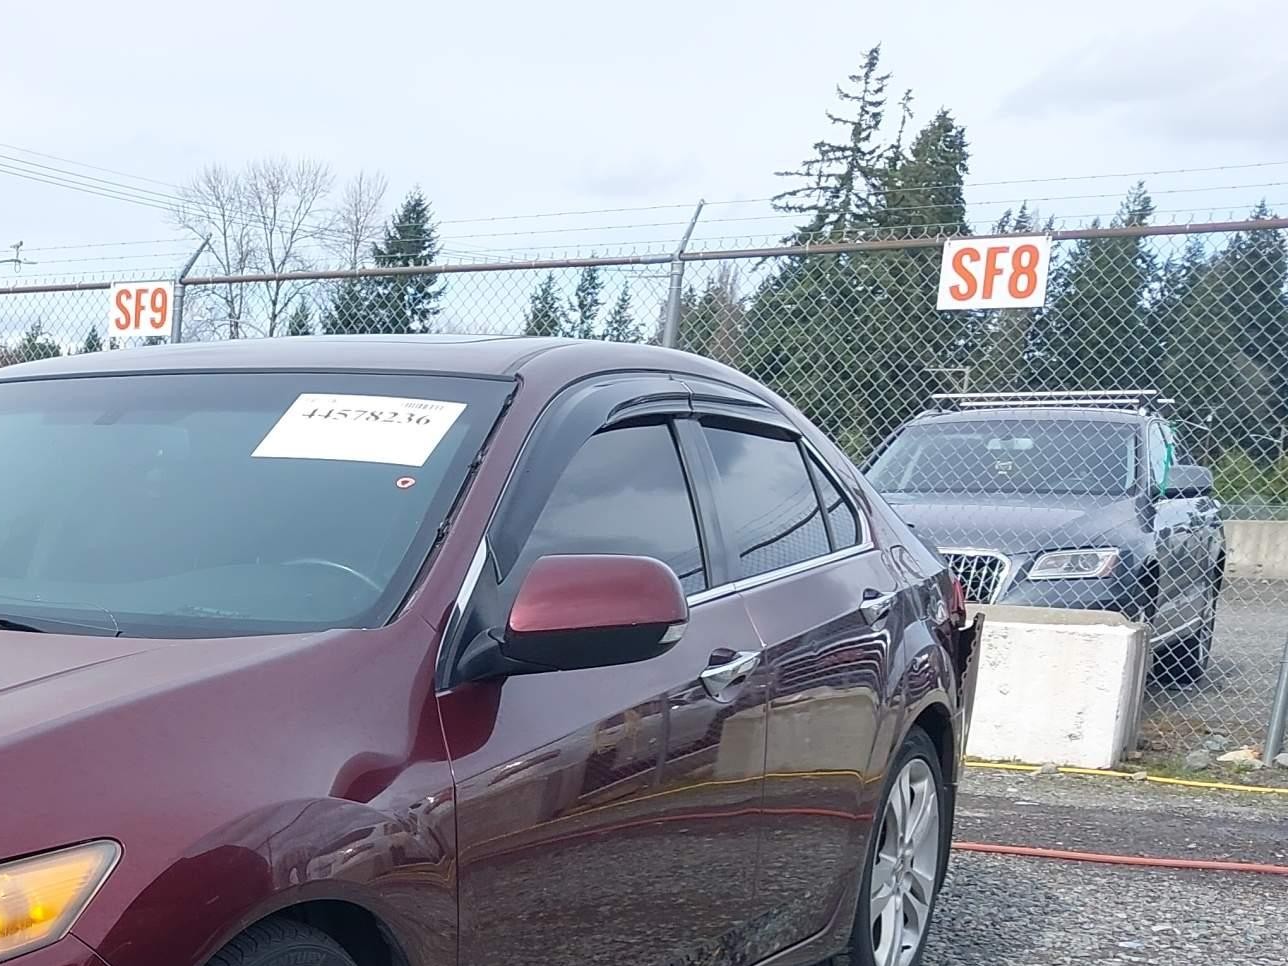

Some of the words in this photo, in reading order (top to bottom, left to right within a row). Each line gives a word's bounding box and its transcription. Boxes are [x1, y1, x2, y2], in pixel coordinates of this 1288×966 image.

[948, 244, 1040, 301] SF8
[115, 287, 168, 330] SF9
[301, 407, 431, 426] 44578236
